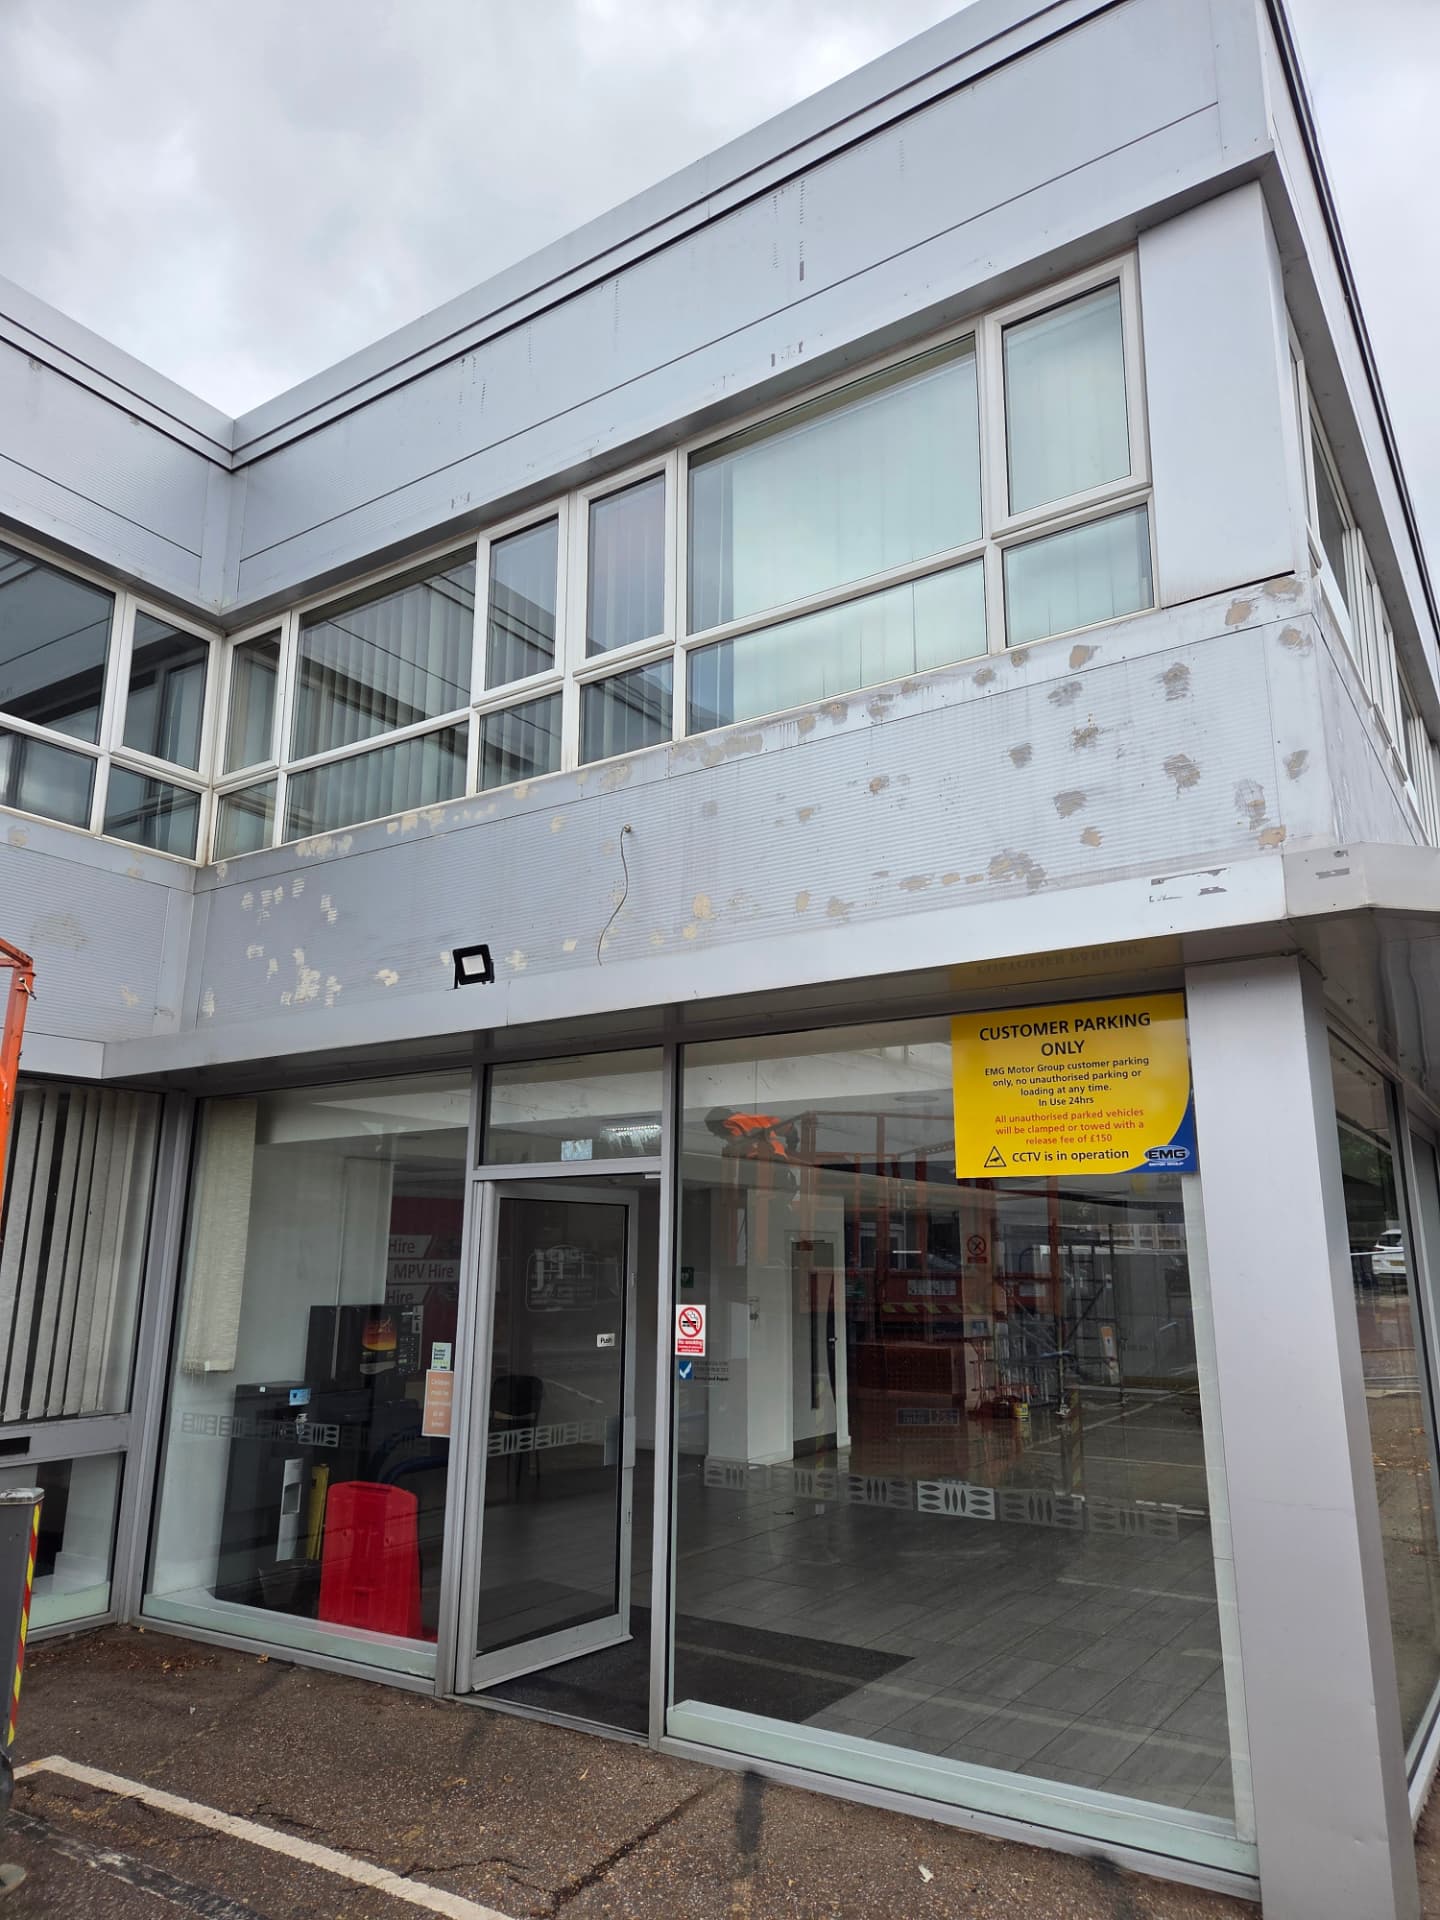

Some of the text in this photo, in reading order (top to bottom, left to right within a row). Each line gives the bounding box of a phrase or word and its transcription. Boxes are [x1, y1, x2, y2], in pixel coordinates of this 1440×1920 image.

[979, 1012, 1151, 1041] CUSTOMER PARKING
[1041, 1040, 1085, 1056] ONLY
[985, 1057, 1149, 1076] EMG Motor Group customer parking
[992, 1078, 1013, 1087] only,
[1029, 1072, 1090, 1084] unauthorised
[1092, 1071, 1128, 1081] parking
[1020, 1087, 1054, 1096] loading
[1069, 1086, 1085, 1094] any
[1088, 1084, 1112, 1092] time.
[1039, 1096, 1094, 1106] In Use 24hrs
[995, 1108, 1144, 1123] All unauthorised parked vehicles
[996, 1126, 1012, 1135] will
[1014, 1126, 1025, 1134] be
[1028, 1124, 1065, 1134] clamped
[1081, 1121, 1111, 1131] towed
[1113, 1120, 1136, 1129] with
[1026, 1137, 1057, 1145] release
[1077, 1134, 1087, 1143] of
[1090, 1134, 1112, 1143] £150
[1012, 1148, 1129, 1163] CCTV is in operation
[1148, 1149, 1186, 1160] EMG
[389, 1239, 415, 1254] Hire
[393, 1263, 454, 1279] MPV Hire
[385, 1289, 414, 1305] Hire
